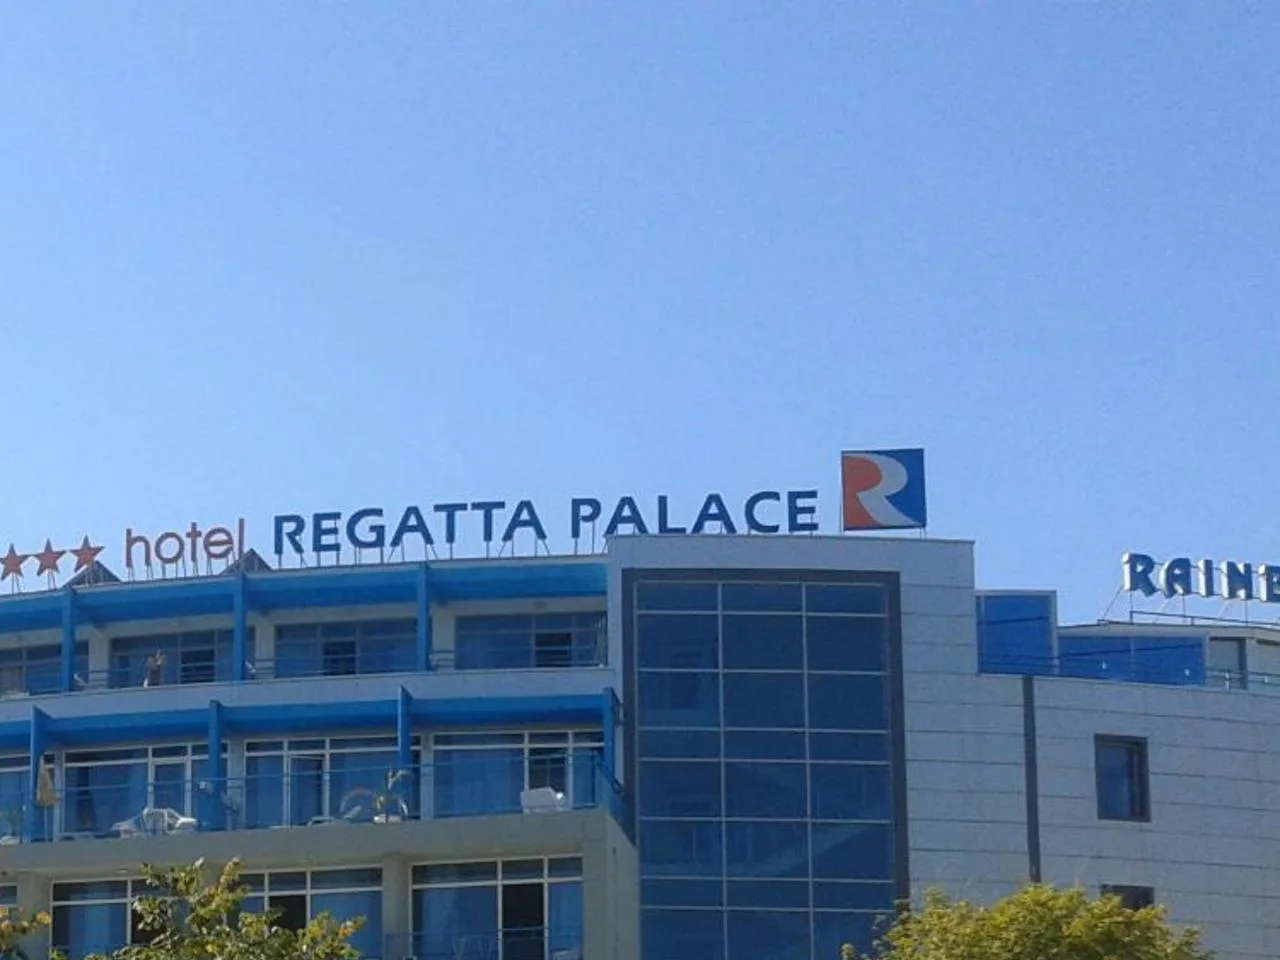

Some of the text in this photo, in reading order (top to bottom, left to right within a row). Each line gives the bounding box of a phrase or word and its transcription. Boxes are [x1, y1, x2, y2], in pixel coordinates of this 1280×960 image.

[125, 490, 819, 567] hotel REGATTA PALACE
